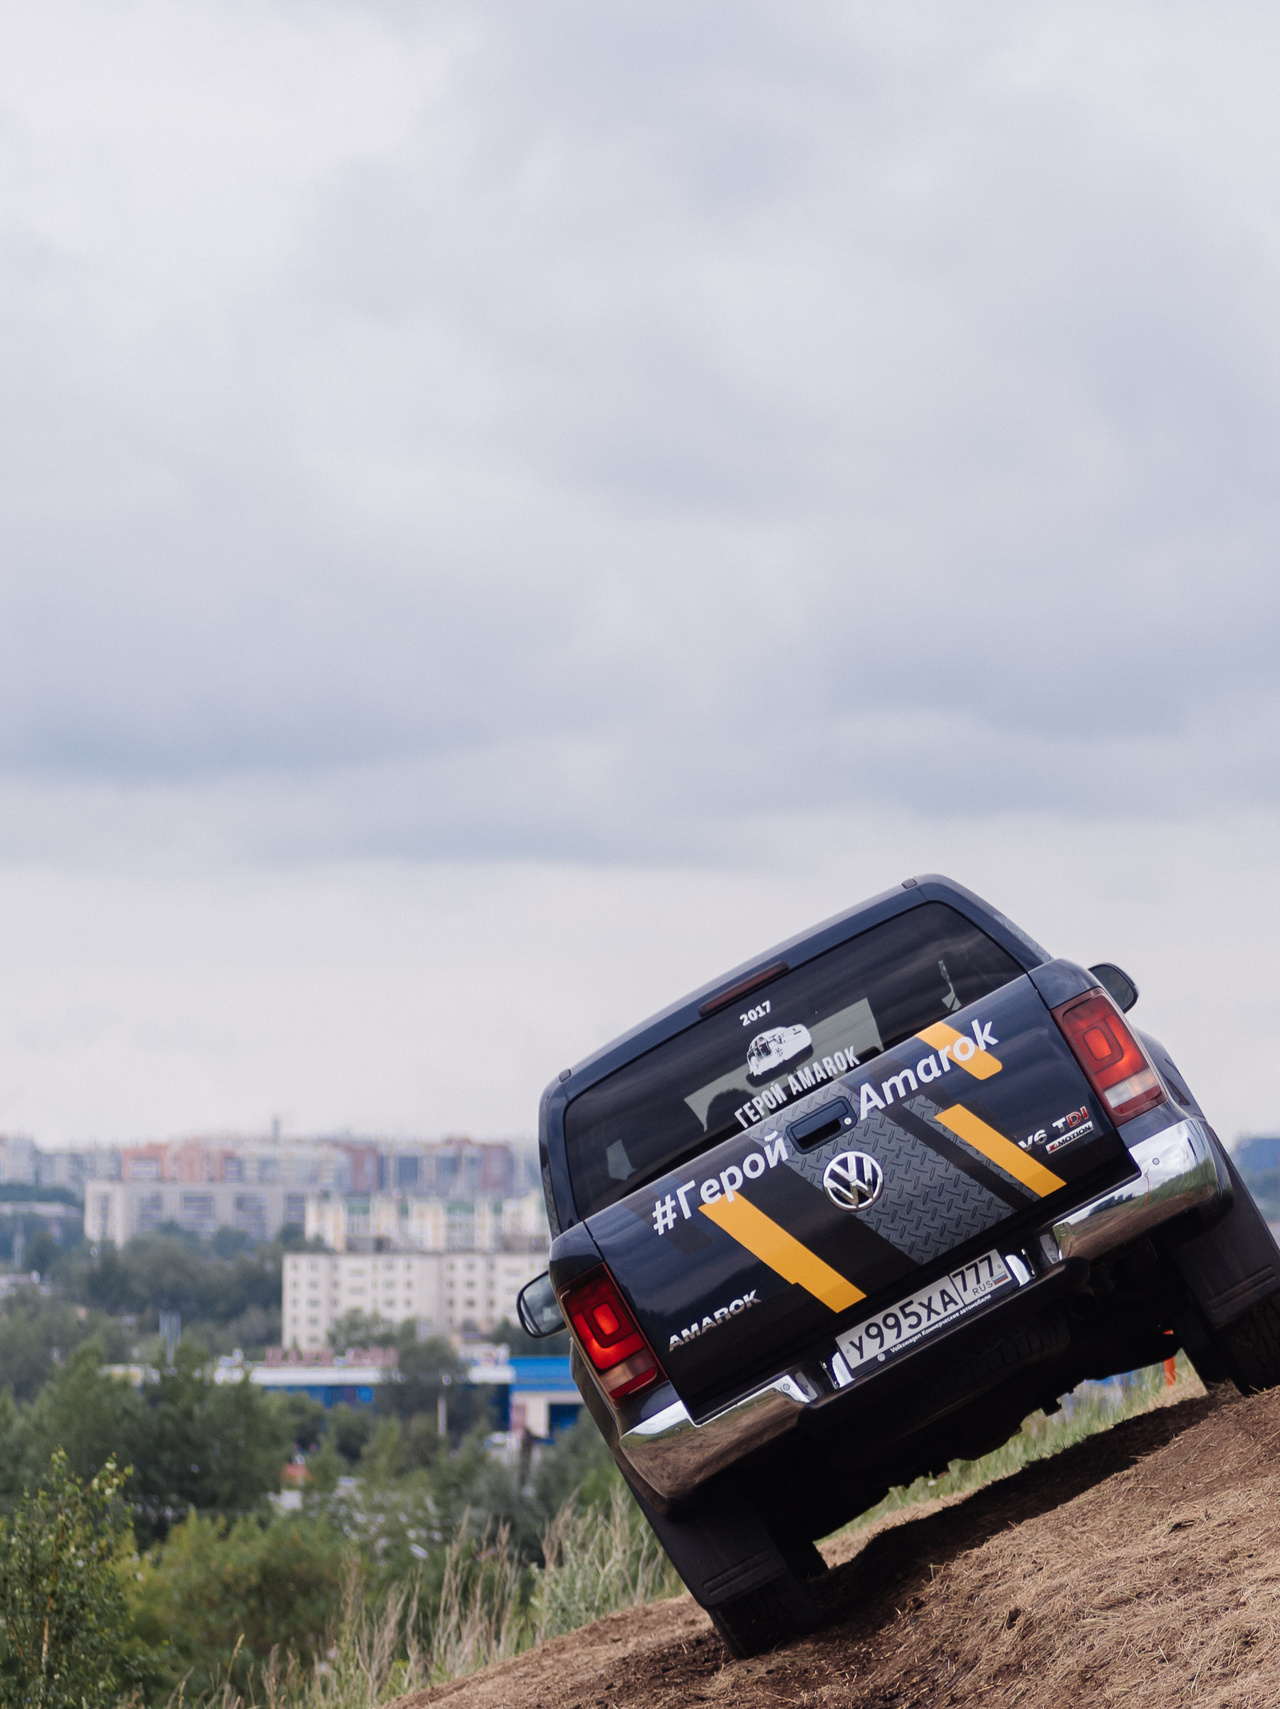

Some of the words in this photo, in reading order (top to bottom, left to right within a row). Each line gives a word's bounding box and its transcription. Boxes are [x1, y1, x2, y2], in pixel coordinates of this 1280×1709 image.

[739, 1000, 772, 1027] 2017
[734, 1083, 788, 1129] ГЕРОЙ
[790, 1045, 861, 1095] AMAROK
[652, 1130, 789, 1235] #Герой
[859, 1018, 999, 1121] Amarok
[1018, 1129, 1048, 1152] V6
[1052, 1105, 1089, 1133] TDI
[972, 1280, 993, 1296] RUS
[669, 1289, 761, 1352] AMAROK
[890, 1333, 922, 1354] Volkswagen
